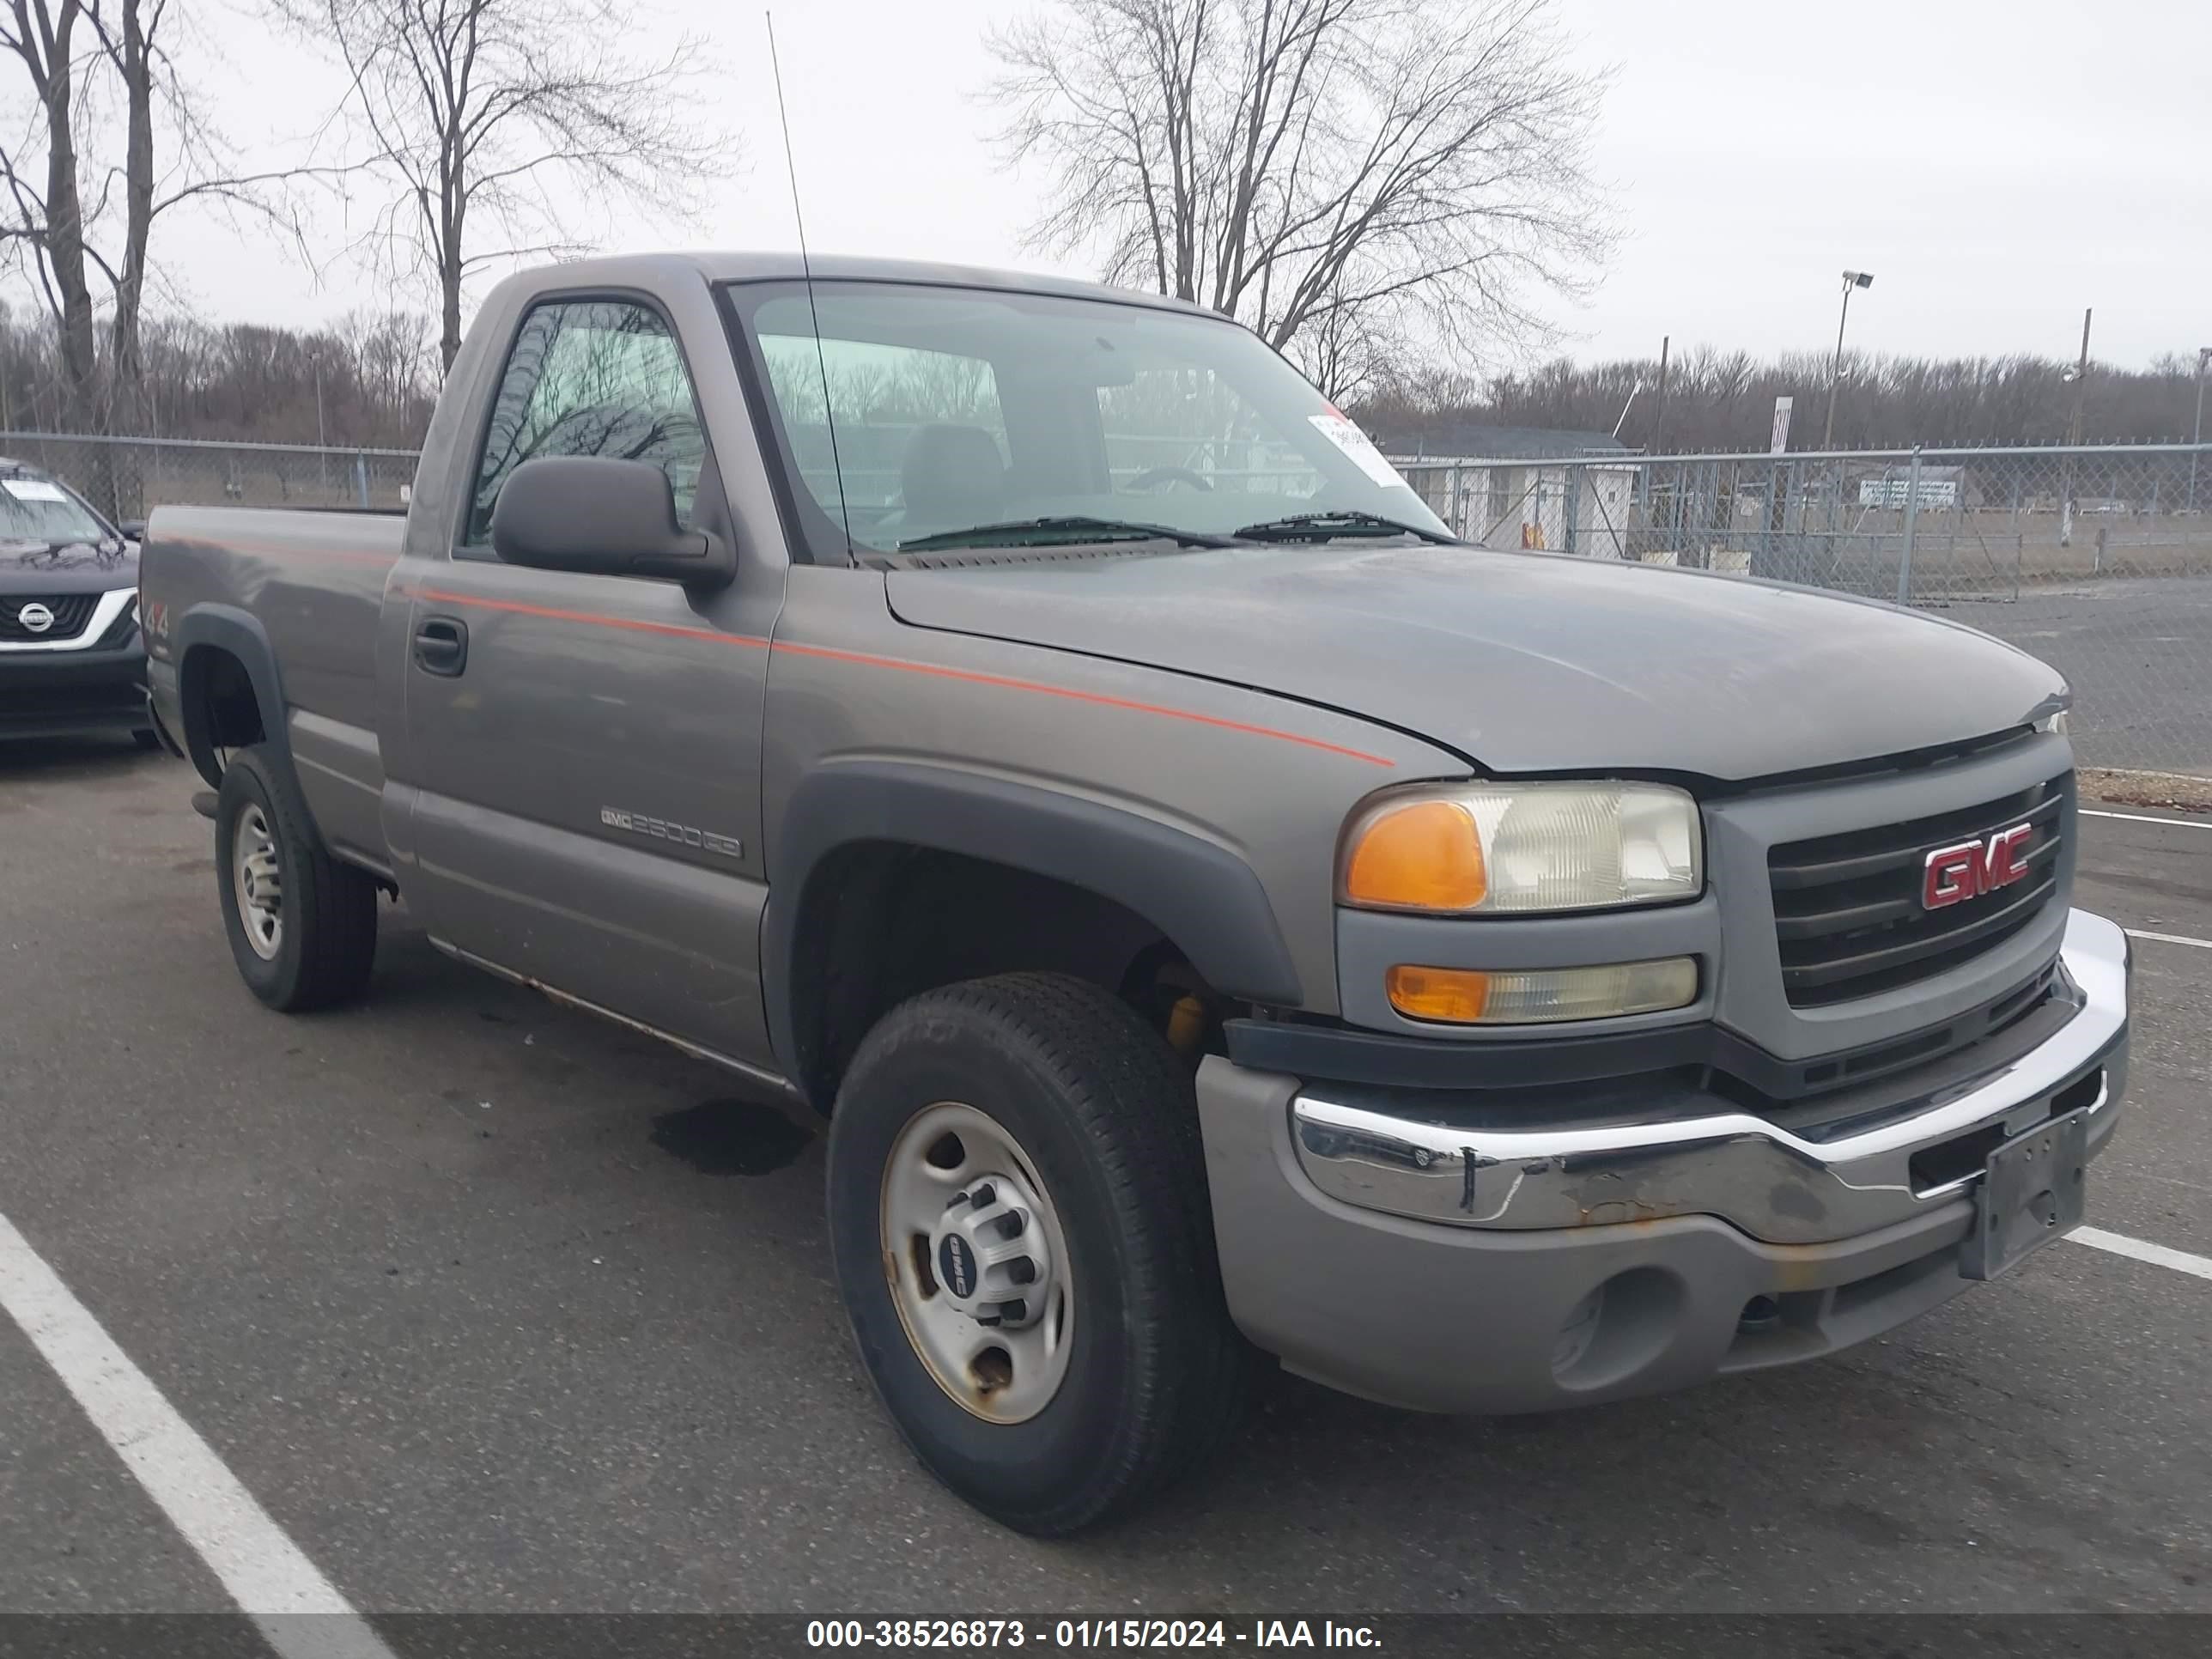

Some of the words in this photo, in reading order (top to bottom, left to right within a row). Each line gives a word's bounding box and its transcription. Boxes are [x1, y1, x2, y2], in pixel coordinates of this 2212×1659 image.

[601, 810, 632, 830] GMC
[1923, 822, 2033, 911] GMC
[950, 1237, 968, 1296] GMC
